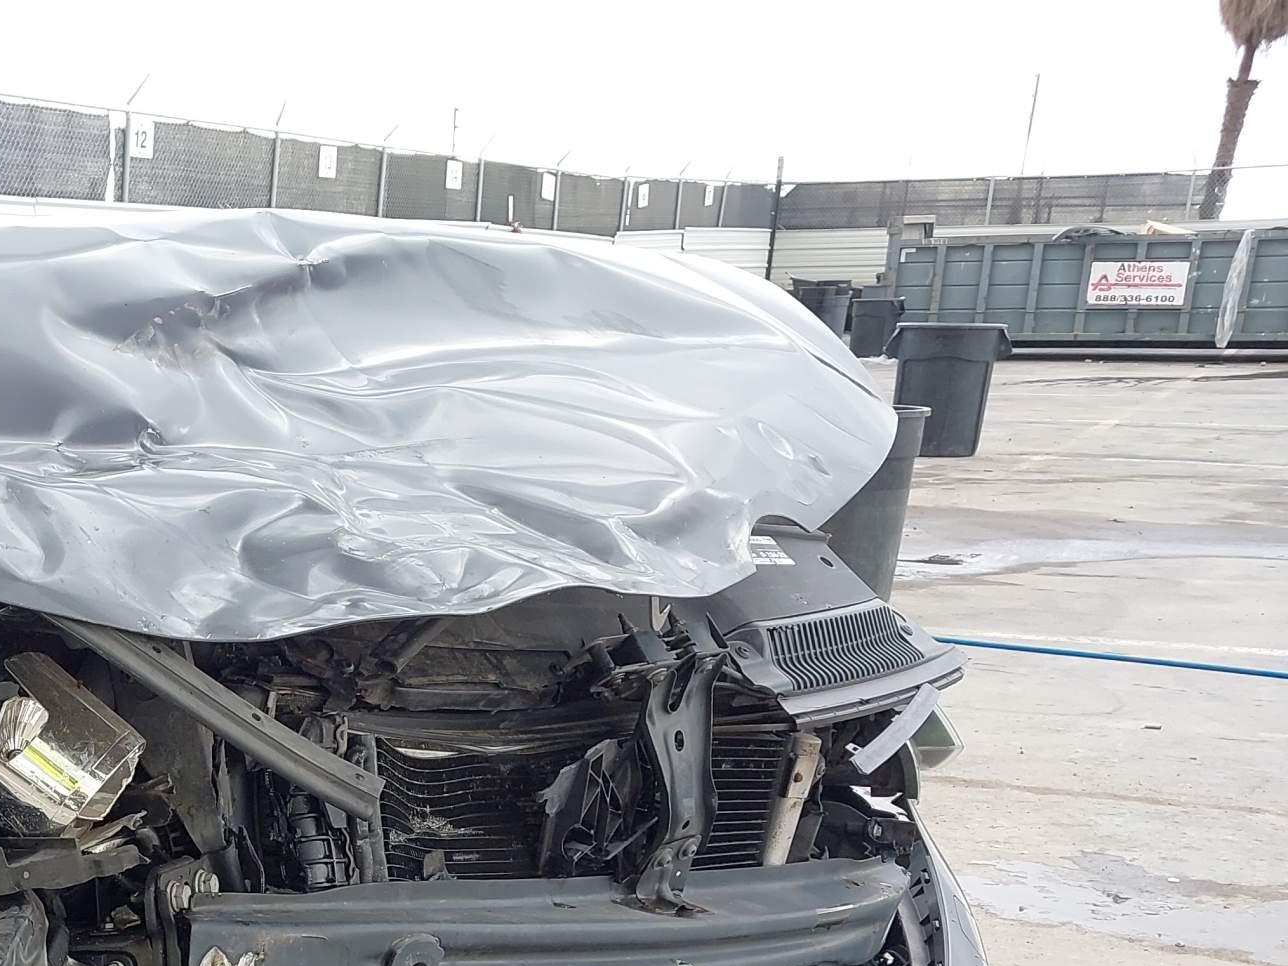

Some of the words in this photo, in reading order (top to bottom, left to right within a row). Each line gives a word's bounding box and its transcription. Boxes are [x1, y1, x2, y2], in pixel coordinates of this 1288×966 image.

[135, 130, 147, 149] 12
[1116, 263, 1164, 273] Athens
[1114, 272, 1173, 283] Services
[1094, 294, 1176, 303] 888/336-6100
